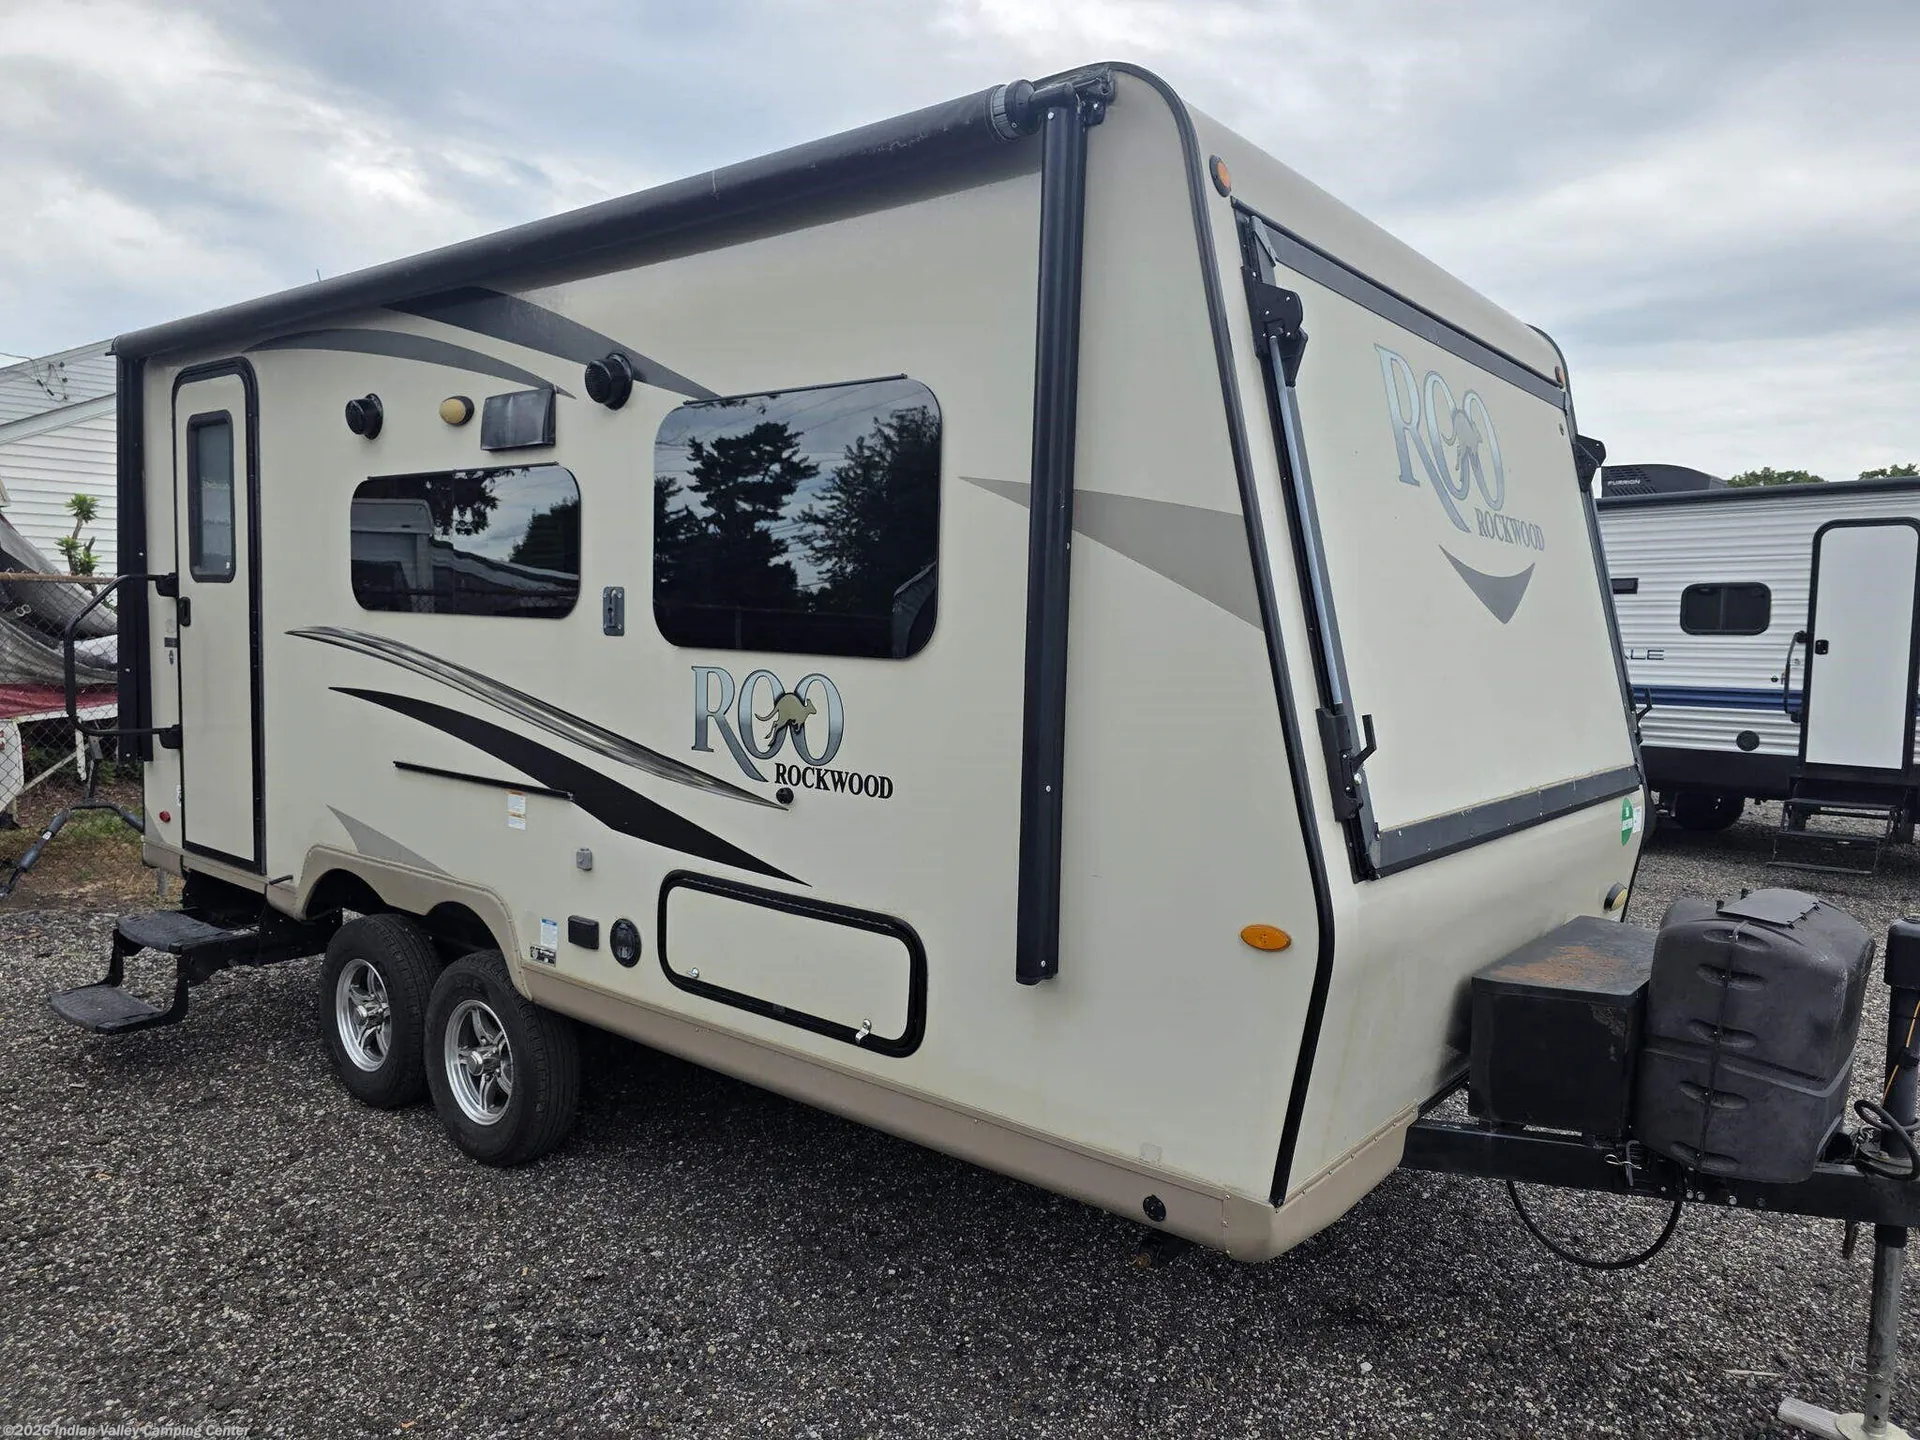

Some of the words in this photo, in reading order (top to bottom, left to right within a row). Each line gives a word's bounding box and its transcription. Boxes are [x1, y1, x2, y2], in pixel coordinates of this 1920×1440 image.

[1374, 343, 1505, 533] ROO
[1474, 507, 1545, 551] ROCKWOOD
[1624, 649, 1665, 660] LE
[691, 665, 845, 783] ROO
[774, 762, 894, 799] ROCKWOOD
